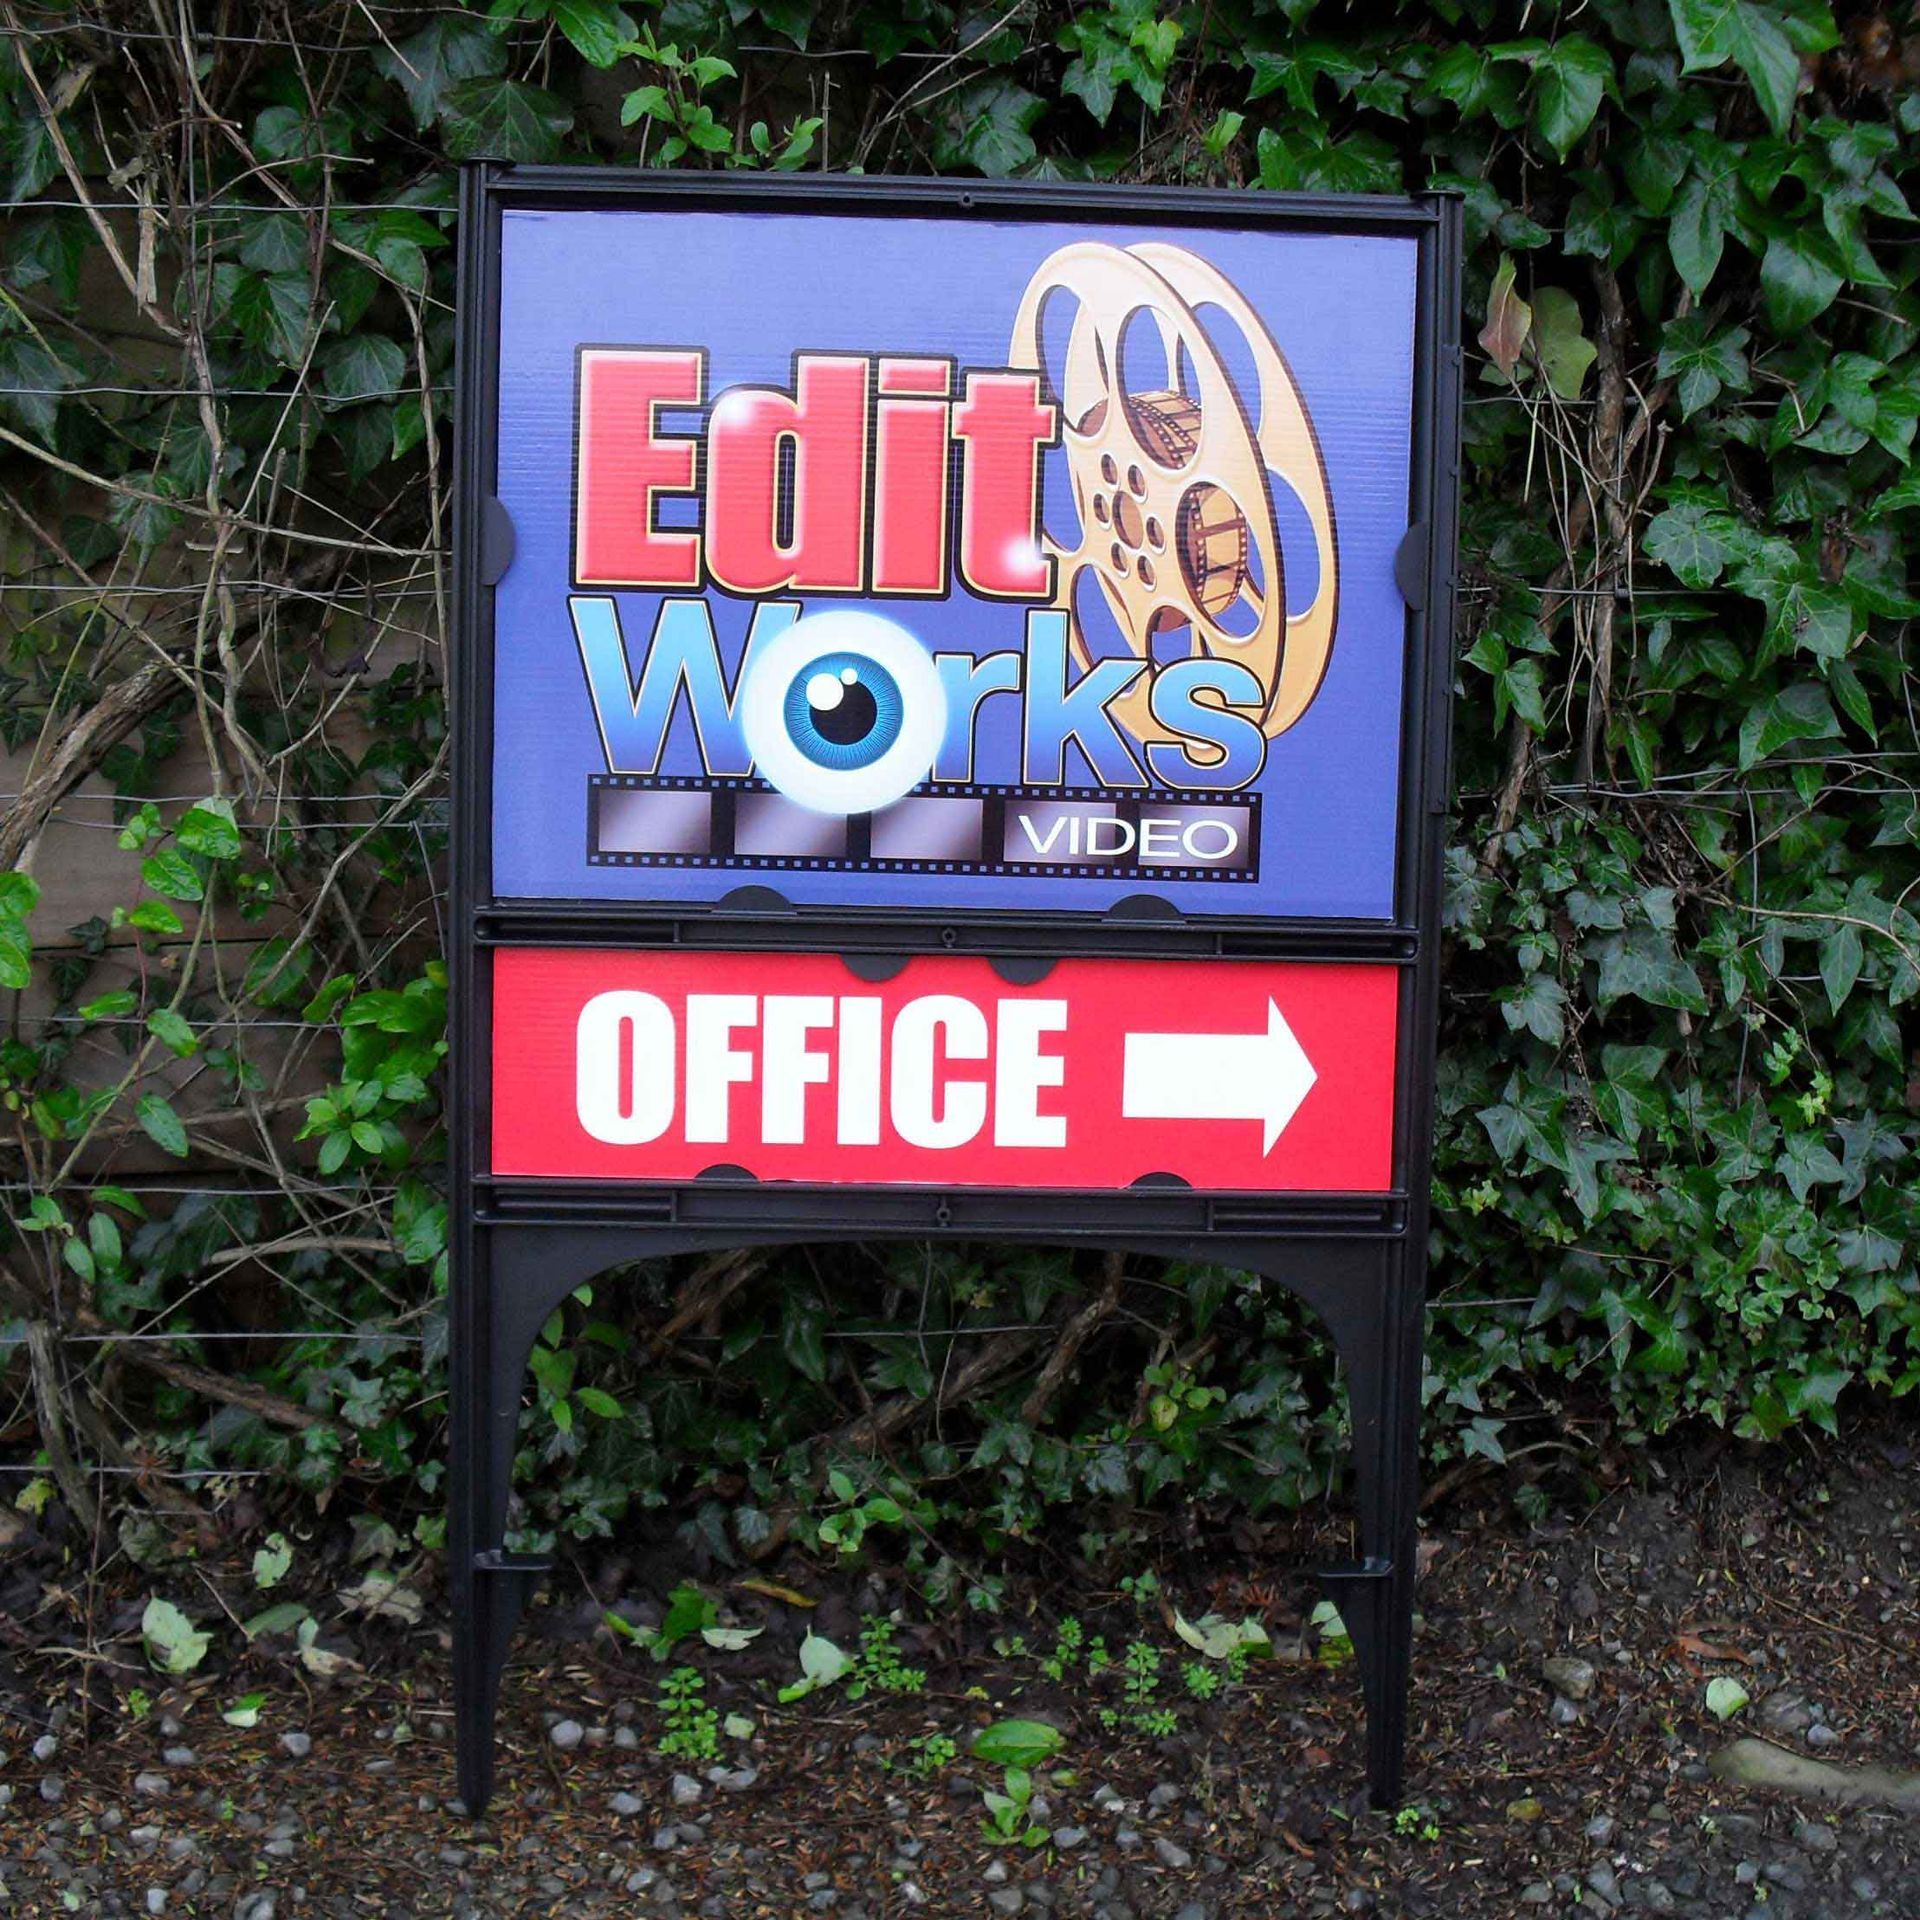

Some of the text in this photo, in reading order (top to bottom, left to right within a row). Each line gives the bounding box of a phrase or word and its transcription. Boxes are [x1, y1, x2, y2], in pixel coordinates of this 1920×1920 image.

[571, 344, 1061, 599] Edit
[568, 596, 1267, 815] Works
[1018, 813, 1239, 861] VIDEO
[575, 989, 1068, 1149] OFFICE
